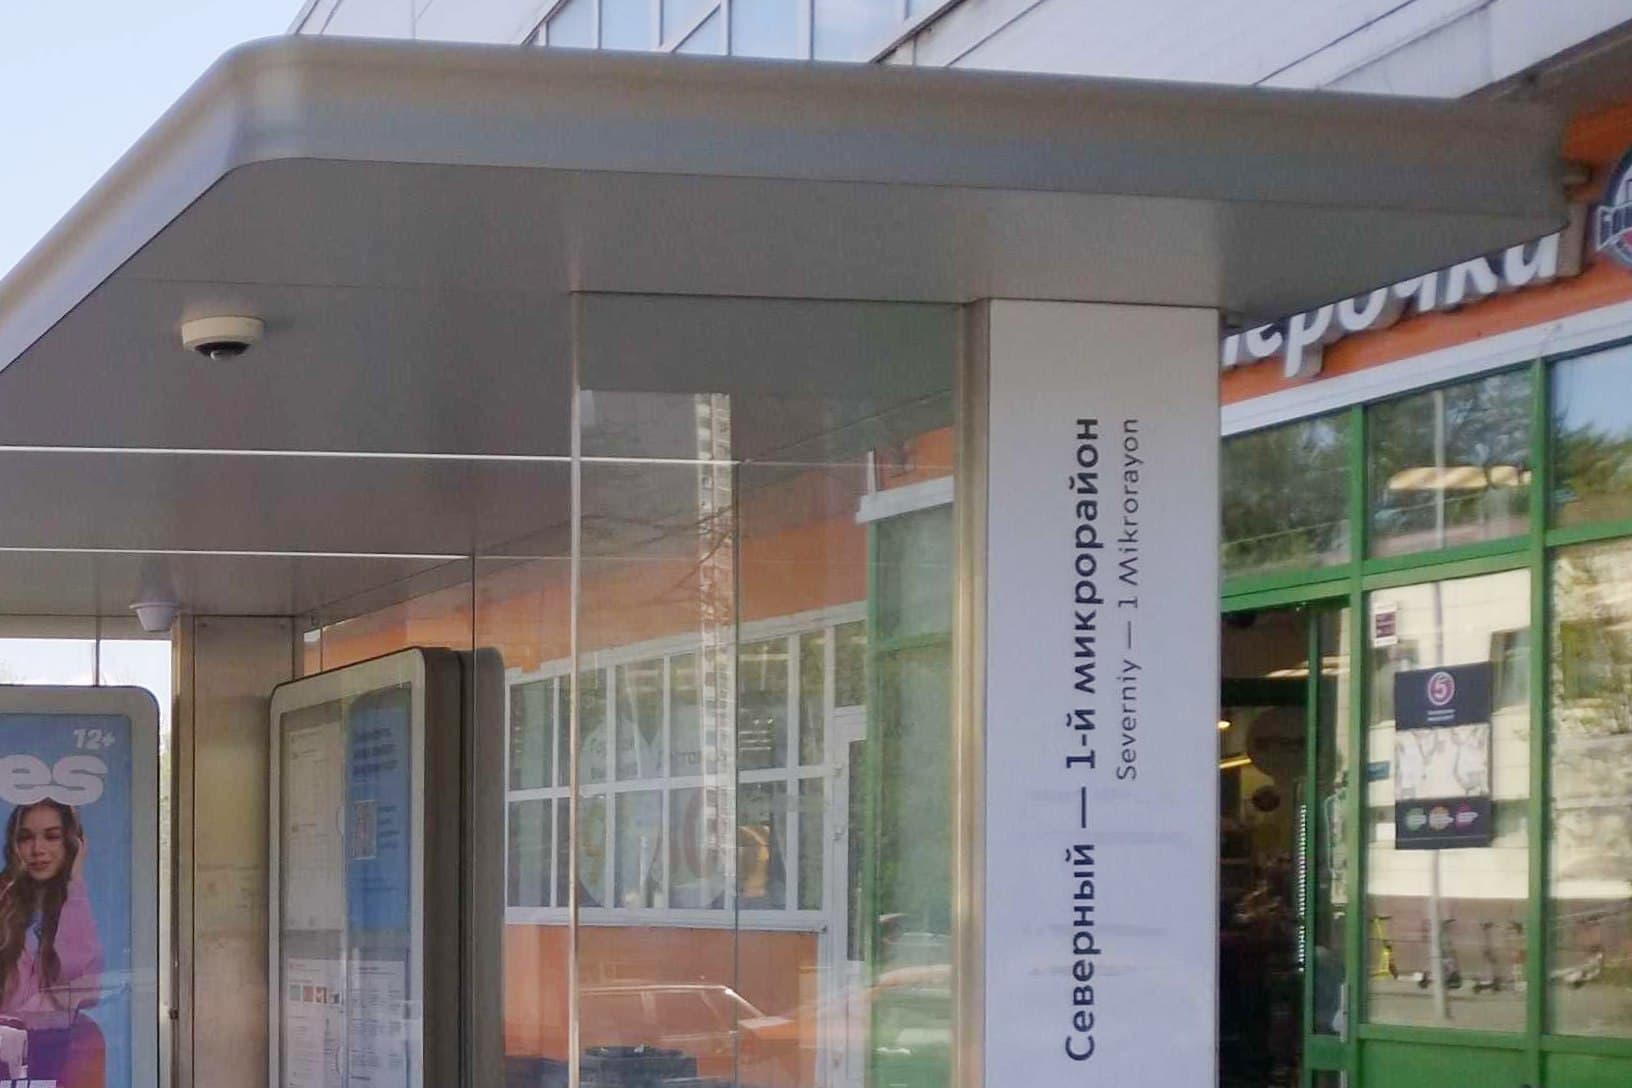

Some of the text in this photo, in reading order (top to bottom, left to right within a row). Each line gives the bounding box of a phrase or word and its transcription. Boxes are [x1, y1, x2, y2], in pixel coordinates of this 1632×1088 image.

[1068, 418, 1105, 694] микрорайон
[1118, 418, 1145, 586] Mikrorayon
[72, 728, 116, 750] 12+
[1066, 709, 1096, 769] 1-й
[1116, 659, 1143, 780] Severniy
[1065, 844, 1101, 1061] Северный
